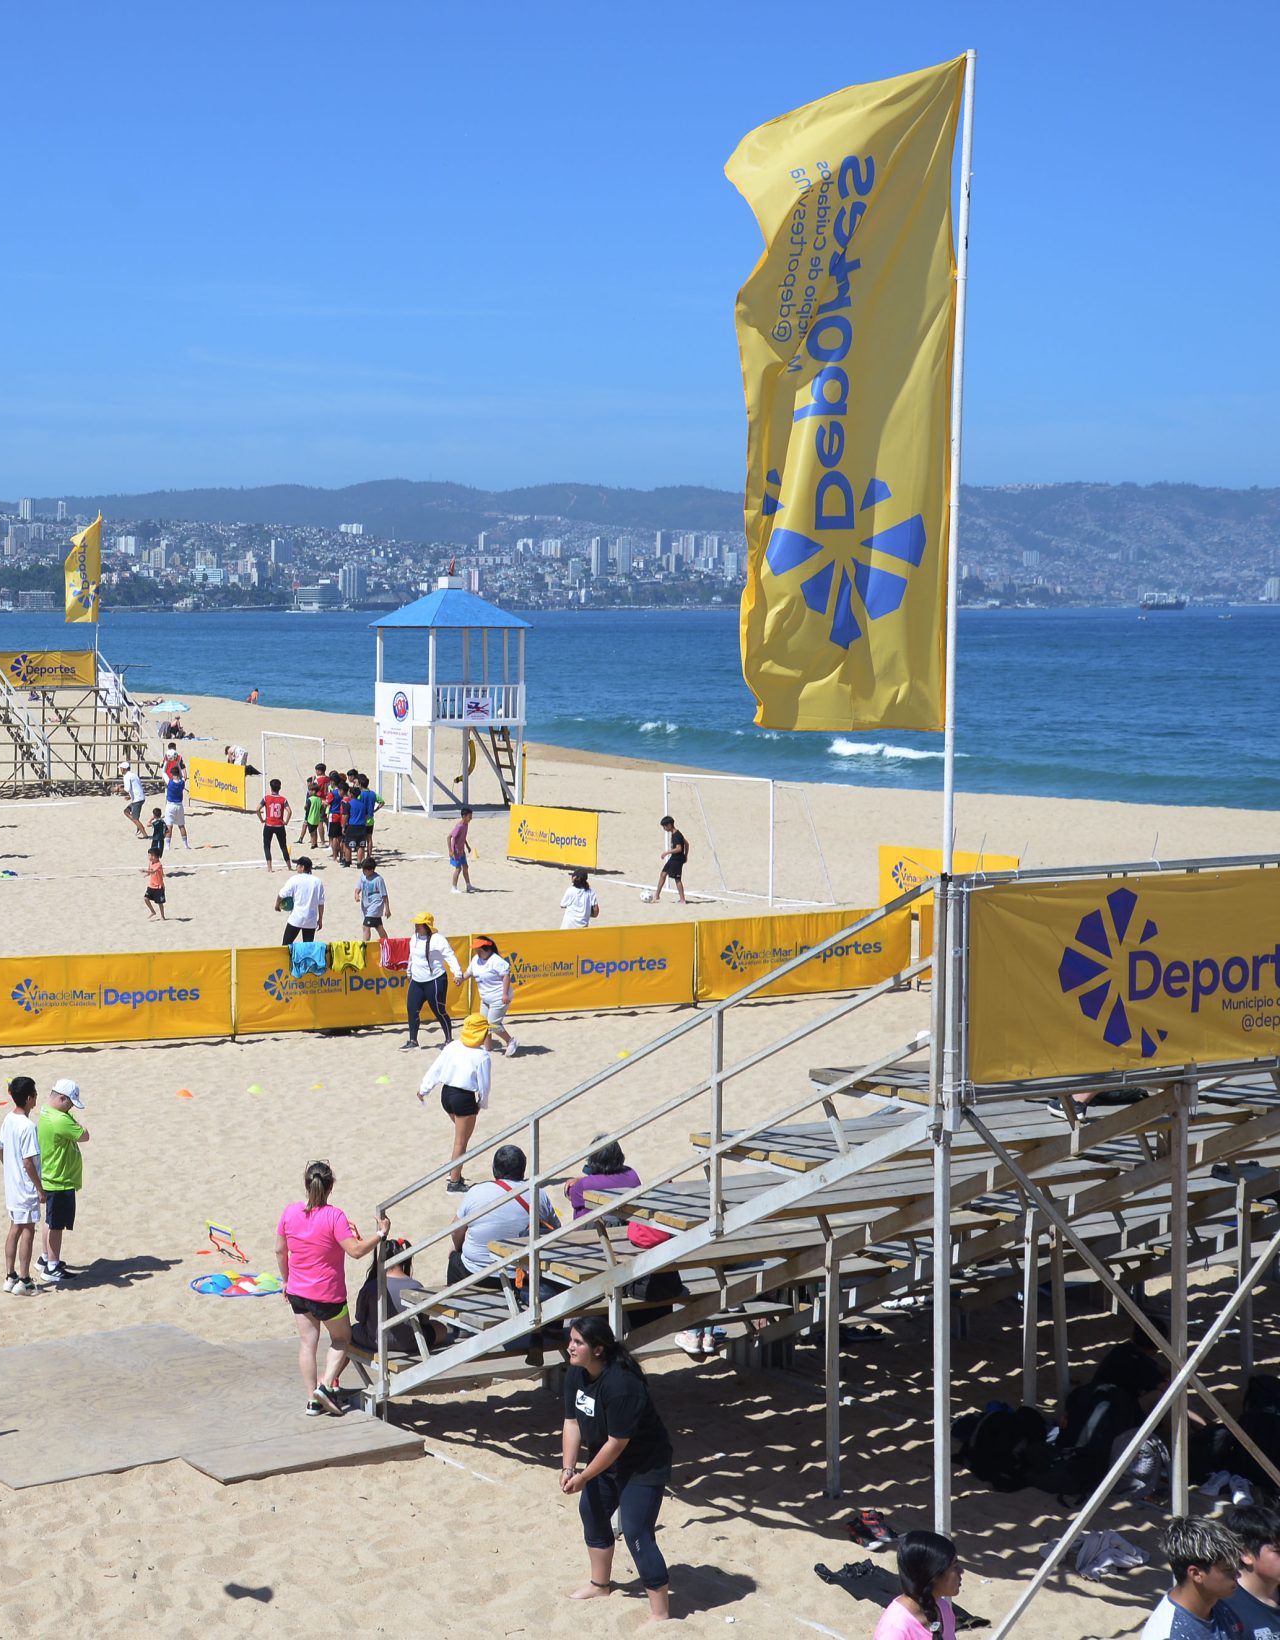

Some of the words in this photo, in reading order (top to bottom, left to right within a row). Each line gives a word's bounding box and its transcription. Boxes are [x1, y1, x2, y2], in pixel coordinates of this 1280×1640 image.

[25, 664, 76, 676] Deportes
[269, 803, 282, 818] 13
[549, 832, 587, 849] Deportes
[580, 956, 667, 978] Deportes
[349, 973, 407, 995] Depor
[103, 986, 201, 1010] Deportes
[1222, 996, 1274, 1012] Municipio
